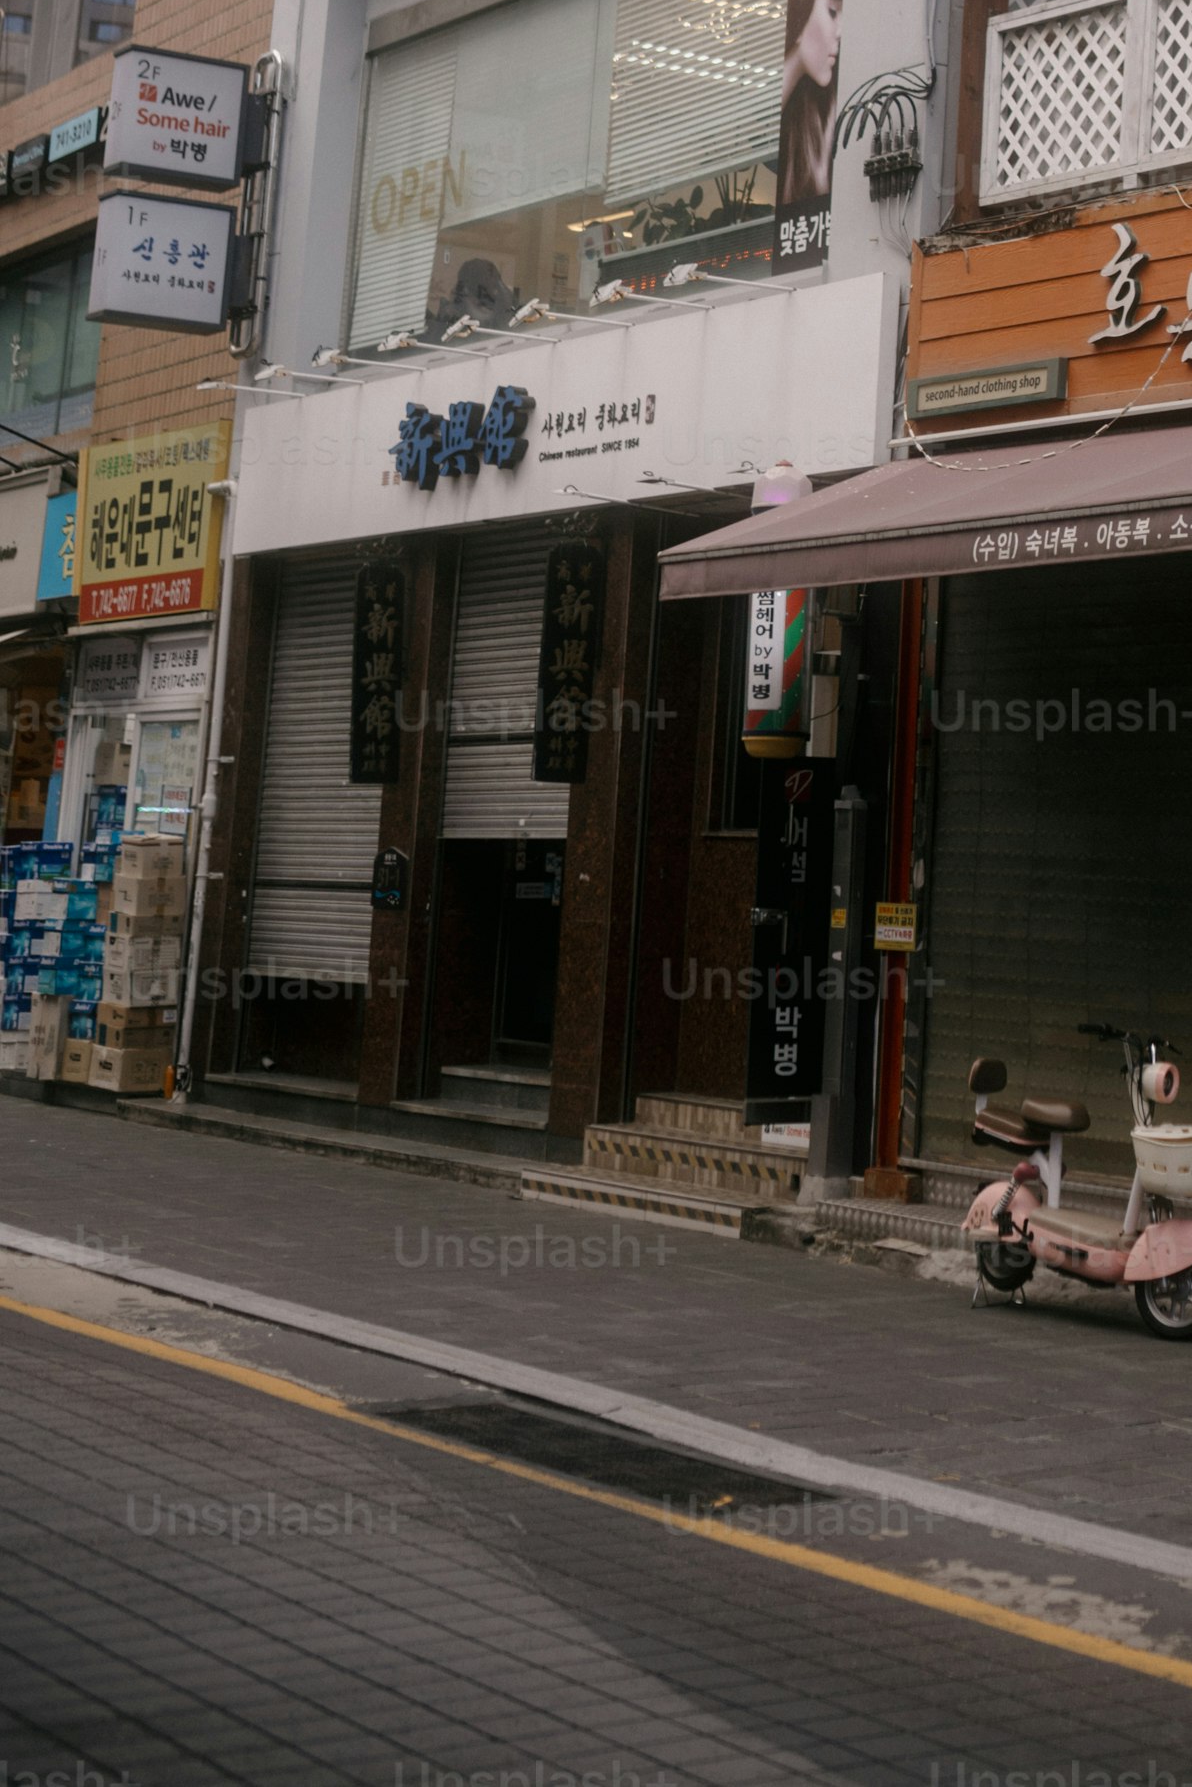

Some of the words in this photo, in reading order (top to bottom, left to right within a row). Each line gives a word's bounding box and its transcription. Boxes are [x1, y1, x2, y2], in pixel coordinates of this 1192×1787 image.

[137, 59, 161, 81] 2F
[137, 108, 190, 132] Some
[194, 116, 231, 138] hair
[153, 141, 166, 153] by
[170, 139, 208, 162] 박병
[370, 148, 468, 235] OPEN
[128, 206, 148, 226] 1F
[925, 381, 980, 402] second-hand
[981, 377, 1017, 394] clothing
[1019, 374, 1041, 389] shop
[539, 451, 563, 462] Chinese
[565, 445, 598, 459] restaurant
[601, 439, 622, 453] SINCE
[624, 437, 640, 450] 1954
[90, 478, 206, 572] 해운대문구센터
[973, 531, 1018, 562] (수입)
[1025, 525, 1077, 557] 숙녀복
[1096, 517, 1151, 549] 아동복
[754, 644, 772, 659] by
[752, 663, 772, 700] 박병
